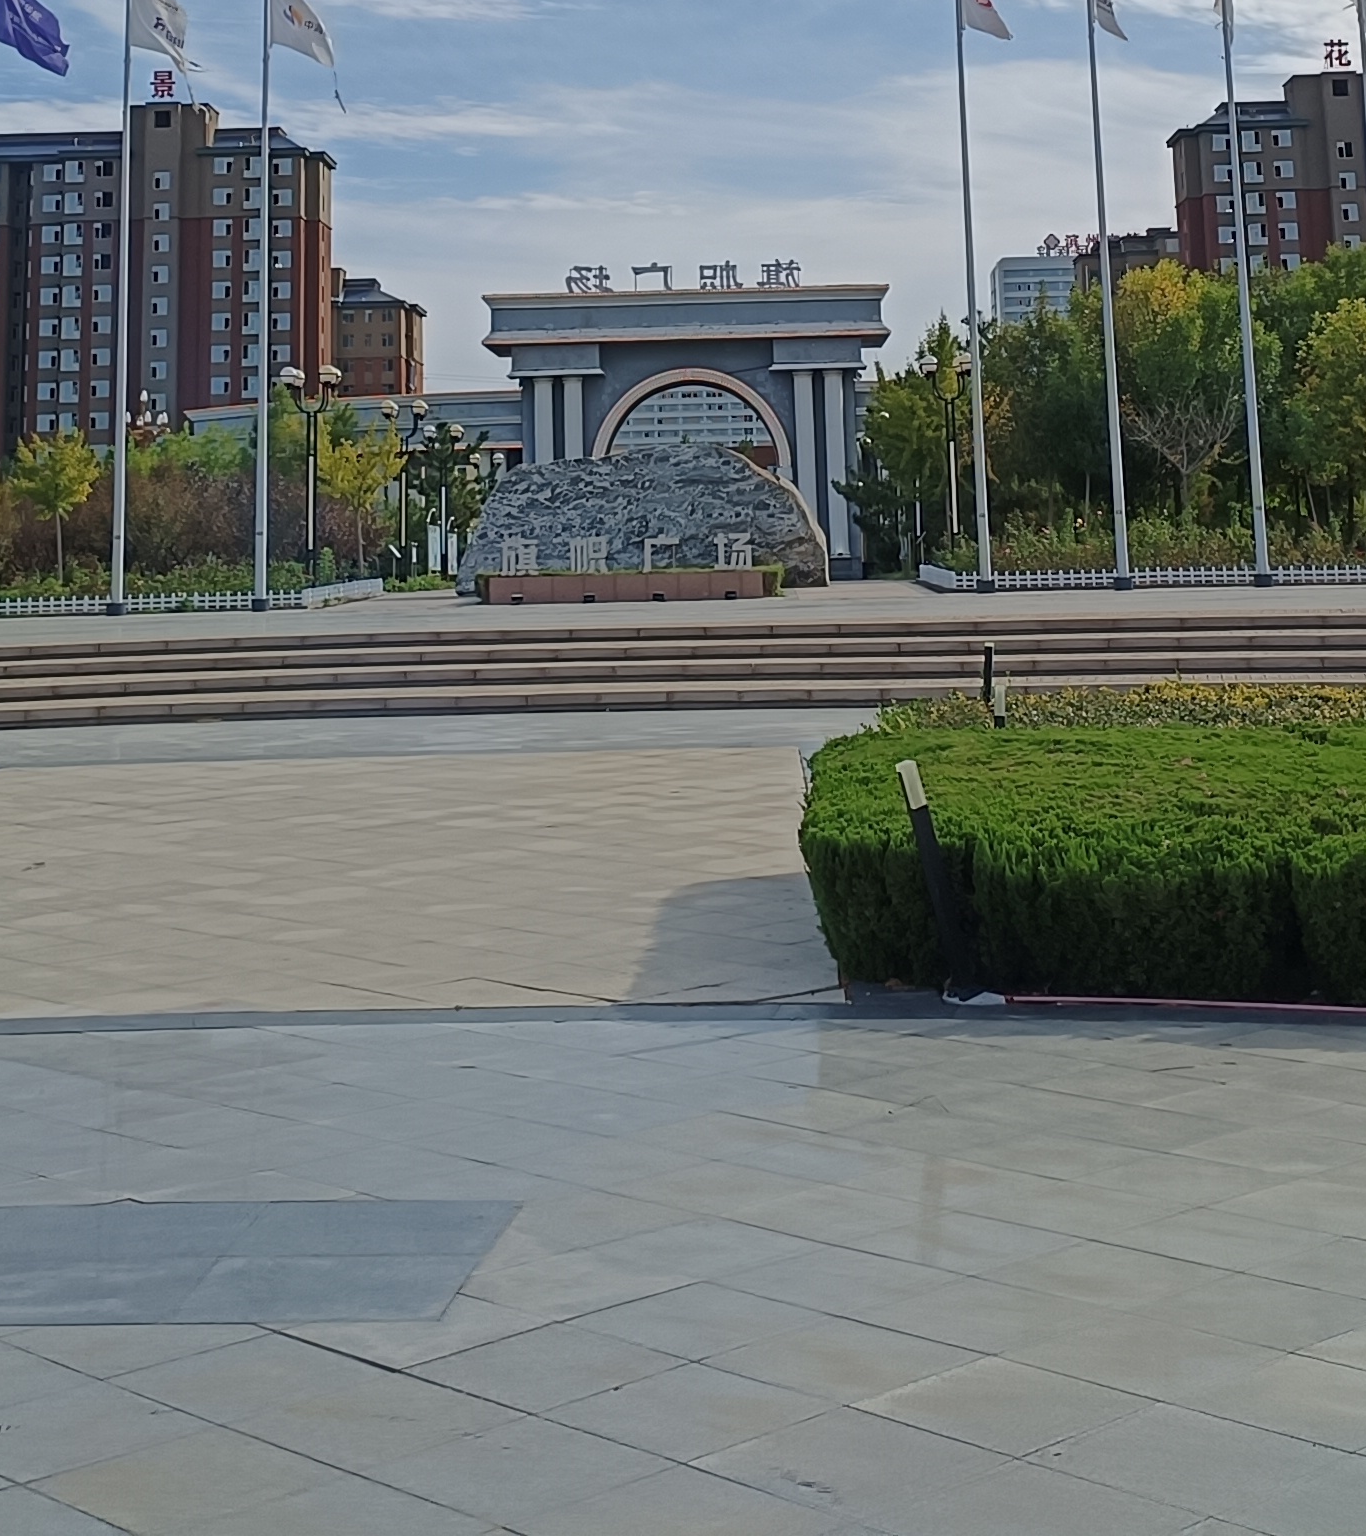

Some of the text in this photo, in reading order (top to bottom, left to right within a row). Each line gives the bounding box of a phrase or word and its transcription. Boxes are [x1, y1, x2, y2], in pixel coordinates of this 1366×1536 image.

[1323, 39, 1352, 68] 花
[150, 70, 176, 98] 景
[501, 532, 753, 576] 旗帜广场
